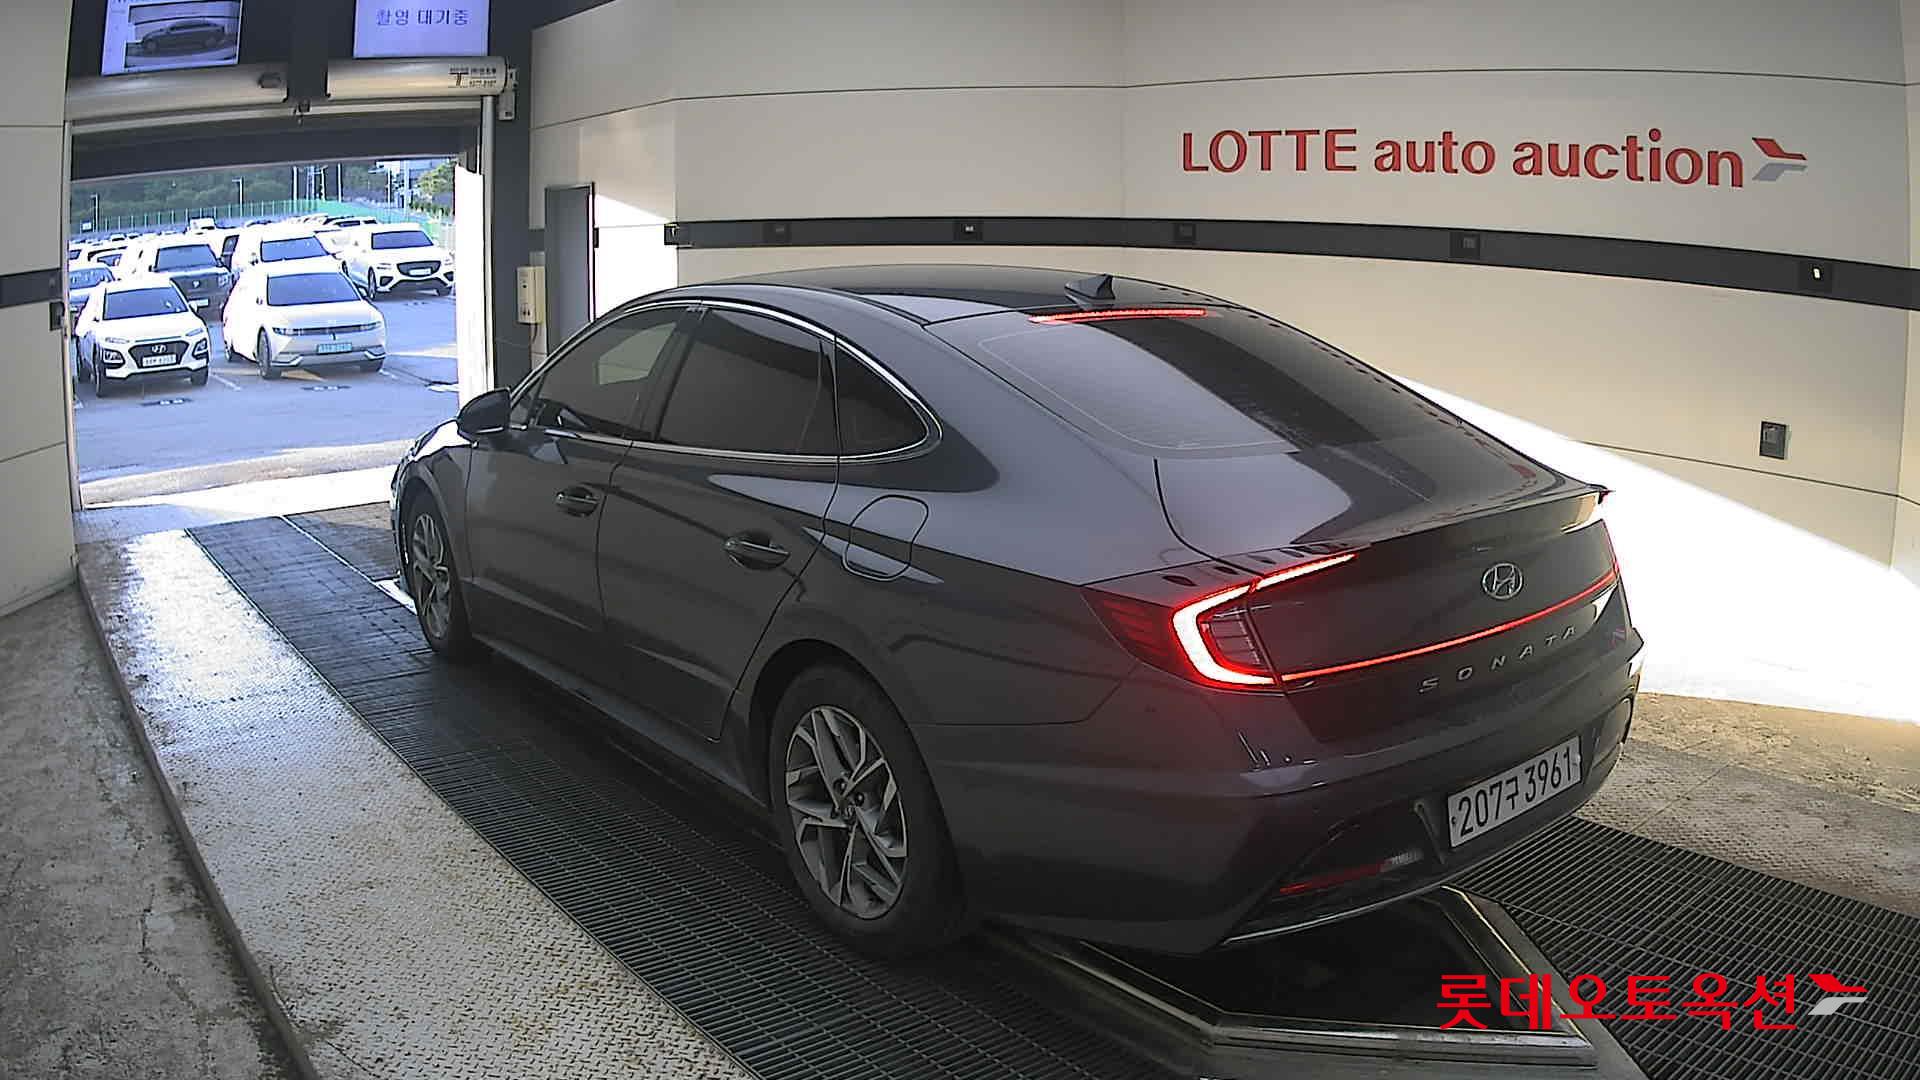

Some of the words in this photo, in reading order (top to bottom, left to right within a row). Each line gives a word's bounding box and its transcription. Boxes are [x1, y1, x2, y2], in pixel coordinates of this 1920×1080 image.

[417, 9, 469, 26] 대기중
[1183, 128, 1357, 174] LOTTE
[1375, 132, 1497, 176] auto
[1512, 128, 1745, 188] auction
[1418, 625, 1576, 693] SONATA
